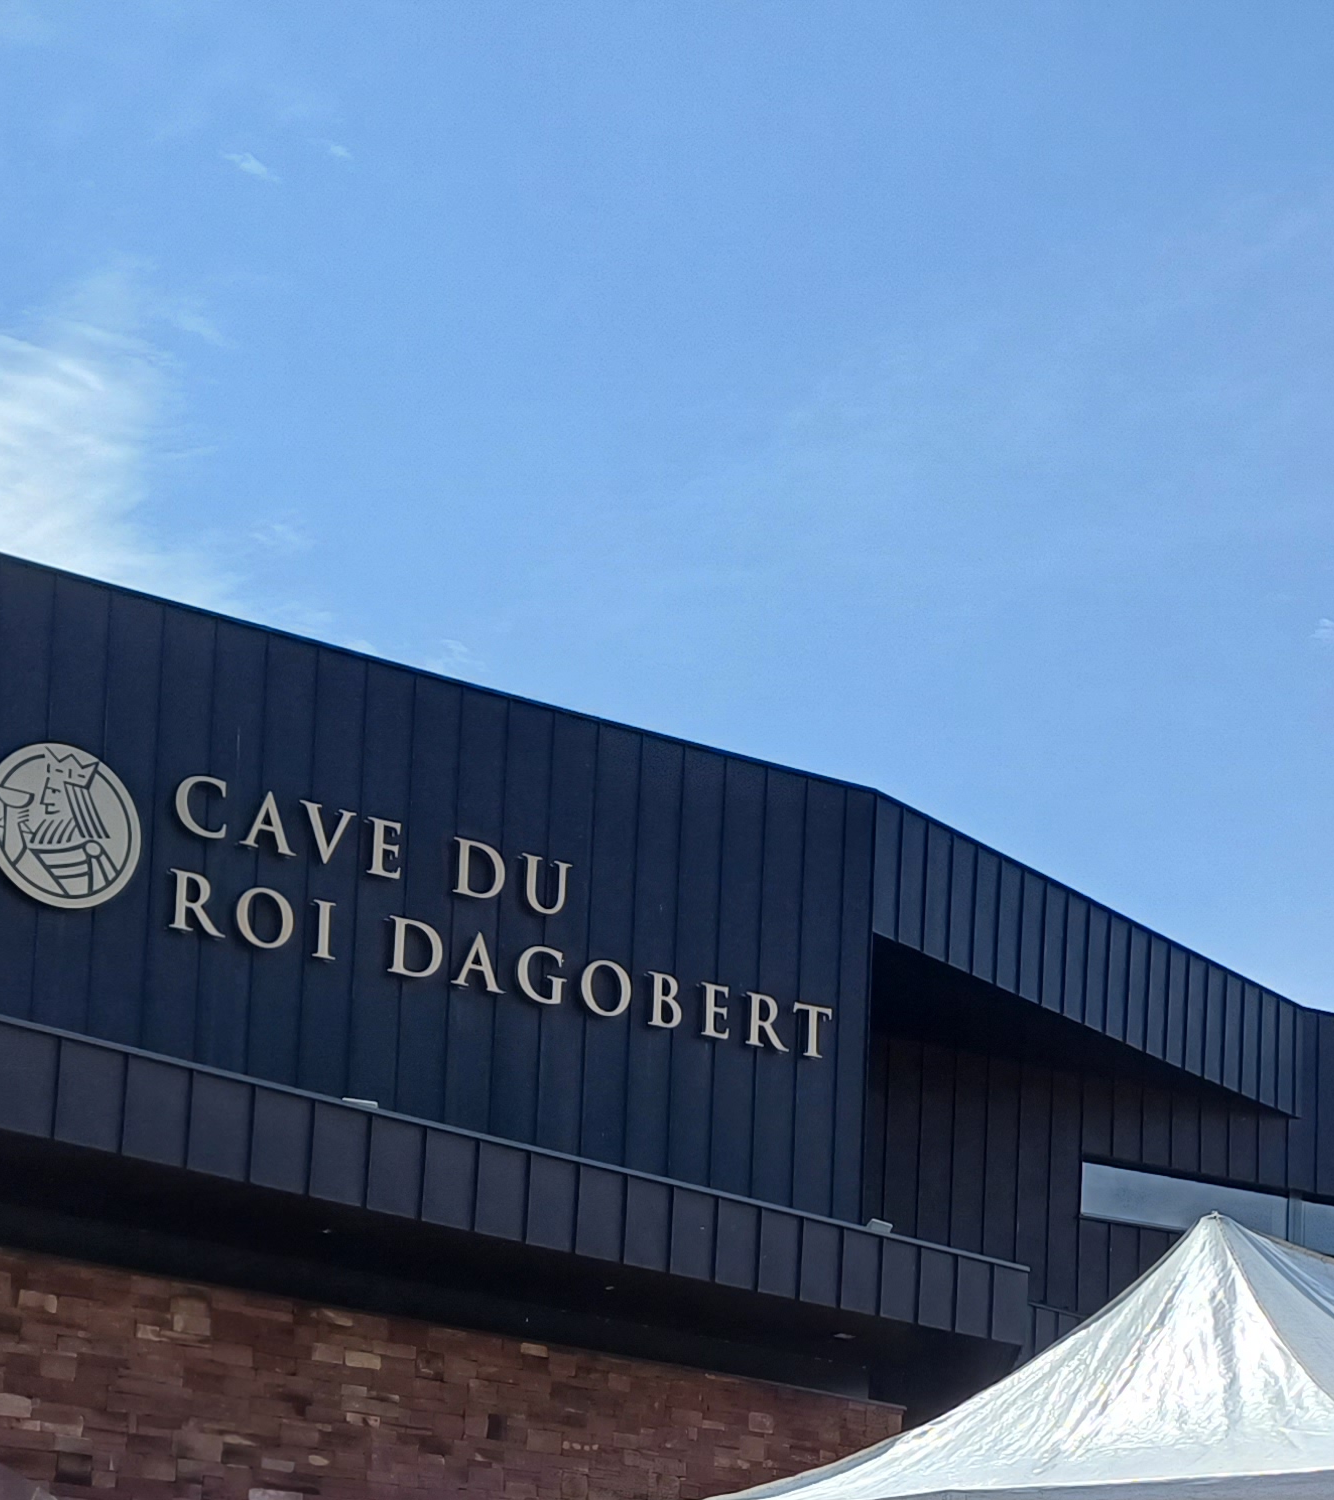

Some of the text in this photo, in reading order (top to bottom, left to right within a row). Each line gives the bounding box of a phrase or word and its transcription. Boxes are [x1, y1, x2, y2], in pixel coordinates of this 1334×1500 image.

[173, 774, 574, 916] CAVE DU
[166, 867, 834, 1061] ROI DAGOBERT
